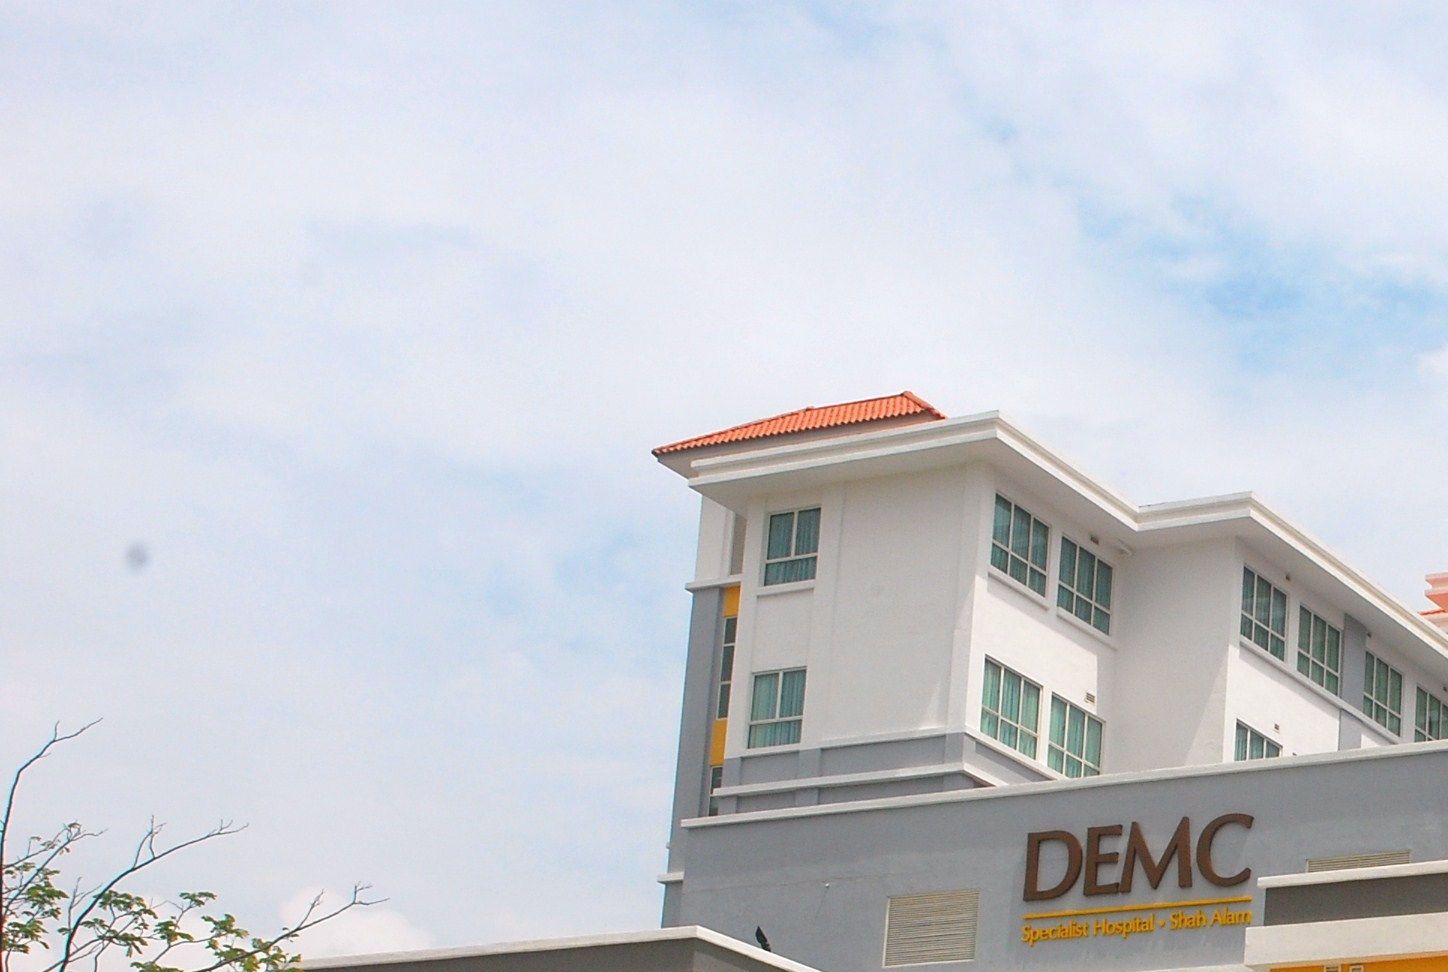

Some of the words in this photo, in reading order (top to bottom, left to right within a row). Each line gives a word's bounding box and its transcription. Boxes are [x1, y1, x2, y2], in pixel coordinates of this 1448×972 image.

[1023, 813, 1254, 902] DEMC
[1021, 921, 1089, 947] Specialist
[1093, 914, 1155, 939] Hospital
[1213, 906, 1253, 924] Alam
